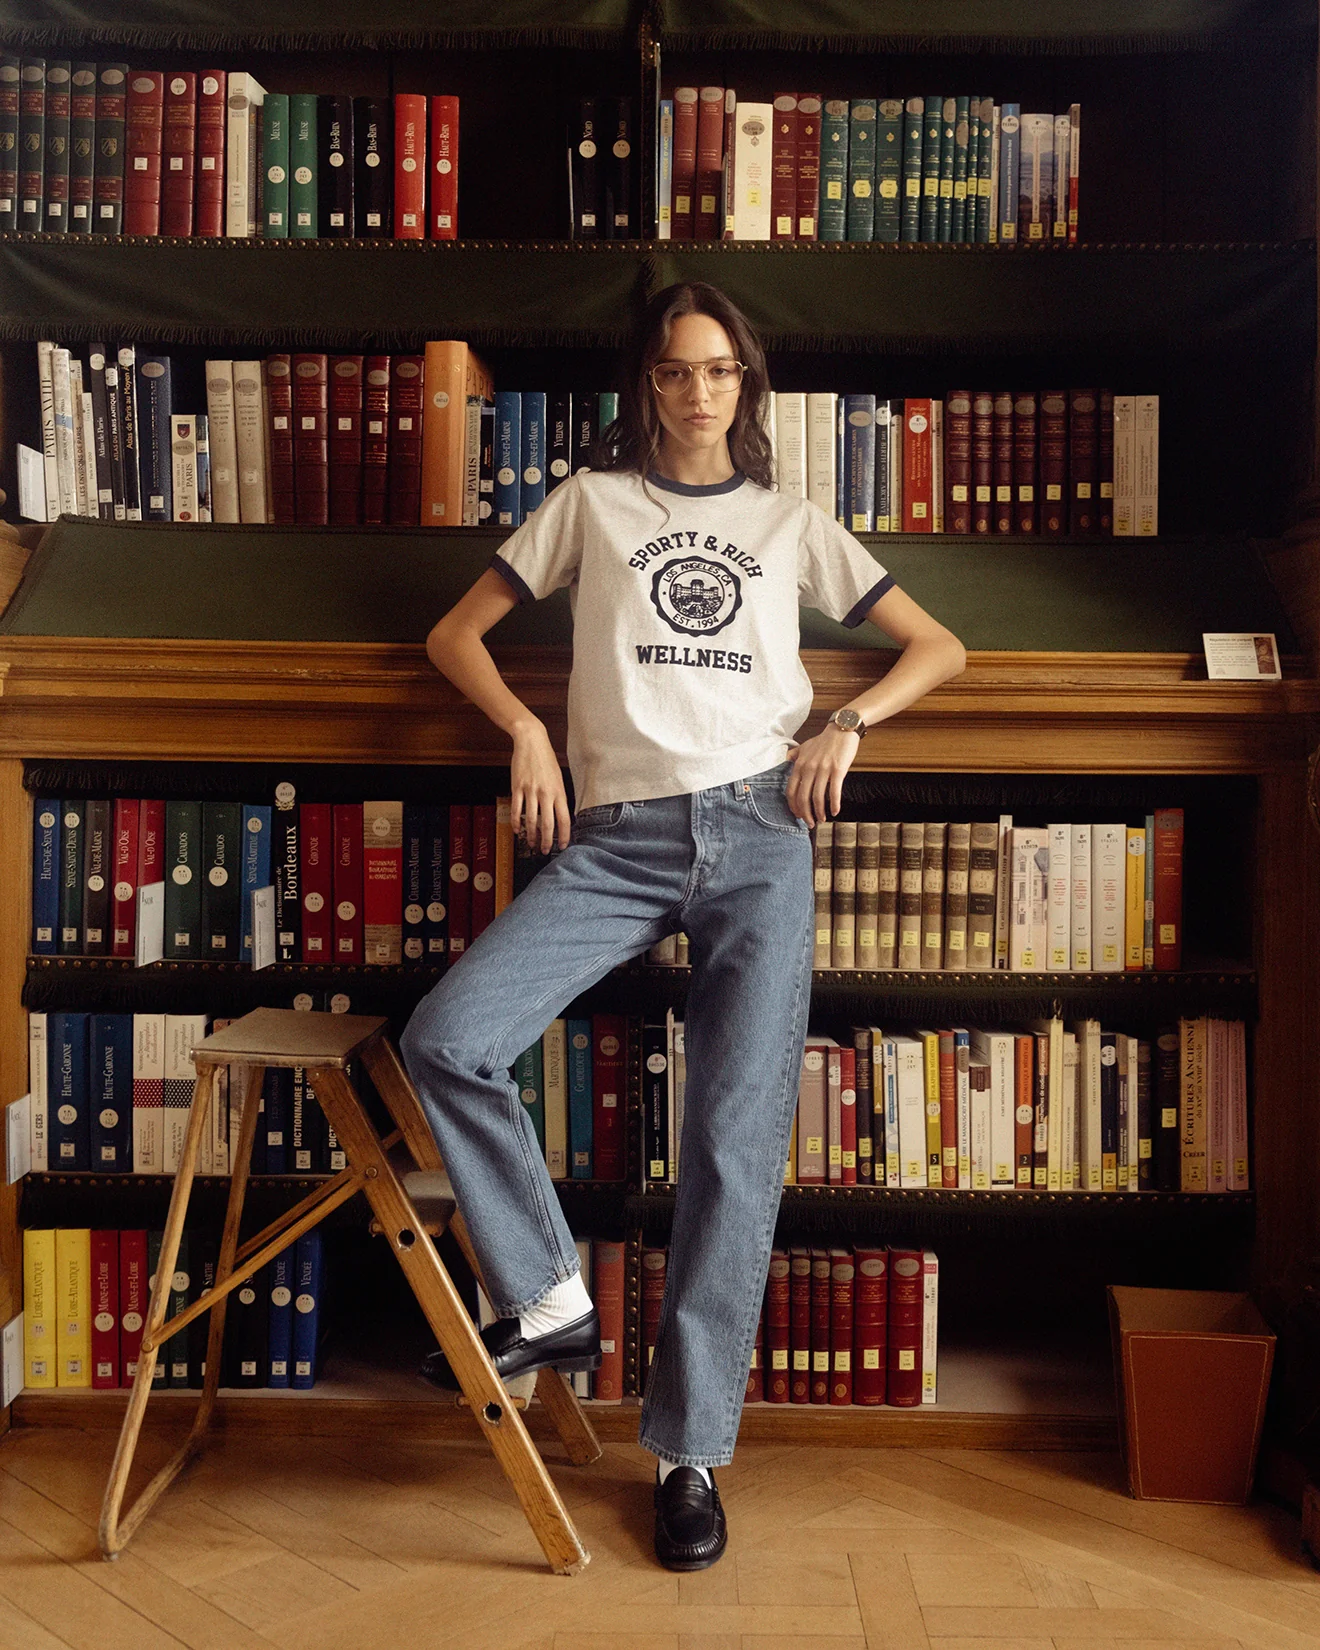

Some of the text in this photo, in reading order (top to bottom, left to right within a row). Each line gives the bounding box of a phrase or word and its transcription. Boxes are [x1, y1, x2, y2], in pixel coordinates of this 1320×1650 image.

[123, 372, 132, 395] Moyen
[125, 396, 131, 404] au
[109, 392, 117, 418] ANTIQUE
[124, 405, 132, 422] Paris
[43, 420, 55, 458] PARIS
[96, 416, 106, 458] Atlas de Paris
[112, 435, 118, 444] DU
[126, 422, 132, 432] de
[126, 432, 134, 449] Atlas
[500, 420, 511, 467] SEINE-ET-MARNE
[528, 420, 539, 467] SEINE-ET-MARNE
[553, 420, 564, 447] YVELINES
[579, 420, 591, 447] YVELINES
[77, 445, 83, 453] DE
[185, 463, 193, 488] PARIS
[467, 457, 477, 492] PARIS
[628, 531, 763, 579] SPORTY & RICH
[663, 568, 678, 583] LOS
[720, 574, 733, 587] CA
[673, 613, 719, 628] EST. 1994
[635, 645, 752, 674] WELLNESS
[41, 829, 53, 880] HAUTS-DE-SEINE
[65, 829, 77, 888] SEINE-SAINT-DENIS
[91, 830, 103, 874] VAL-DE-MARNE
[118, 829, 130, 865] VAL-D'OISE
[144, 831, 156, 866] VAL-D'OISE
[176, 832, 189, 864] CALVADOS
[213, 834, 225, 866] CALVADOS
[283, 825, 298, 901] Bordeaux
[308, 836, 319, 866] GIRONDE
[339, 836, 351, 866] GIRONDE
[452, 836, 464, 860] VIENNE
[476, 836, 488, 861] VIENNE
[408, 837, 420, 901] CHARENTE-MARITIME
[275, 866, 283, 928] Le Dictionnaire de
[61, 1043, 73, 1097] HAUTE-GARONNE
[102, 1045, 114, 1100] HAUTE-GARONNE
[523, 1079, 534, 1088] LA
[549, 1049, 560, 1089] MARTINIQUE
[574, 1050, 585, 1093] GUADELOUPE
[36, 1113, 44, 1129] GERS
[293, 1086, 303, 1148] DICTIONNAIRE
[1182, 1083, 1194, 1145] ÉCRITURES
[36, 1131, 44, 1139] LE
[33, 1260, 45, 1319] LOIRE-ATLANTIQUE
[68, 1260, 80, 1318] LOIRE-ATLANTIQUE
[98, 1262, 110, 1312] MAINE-ET-LOIRE
[127, 1260, 139, 1311] MAINE-ET-LOIRE
